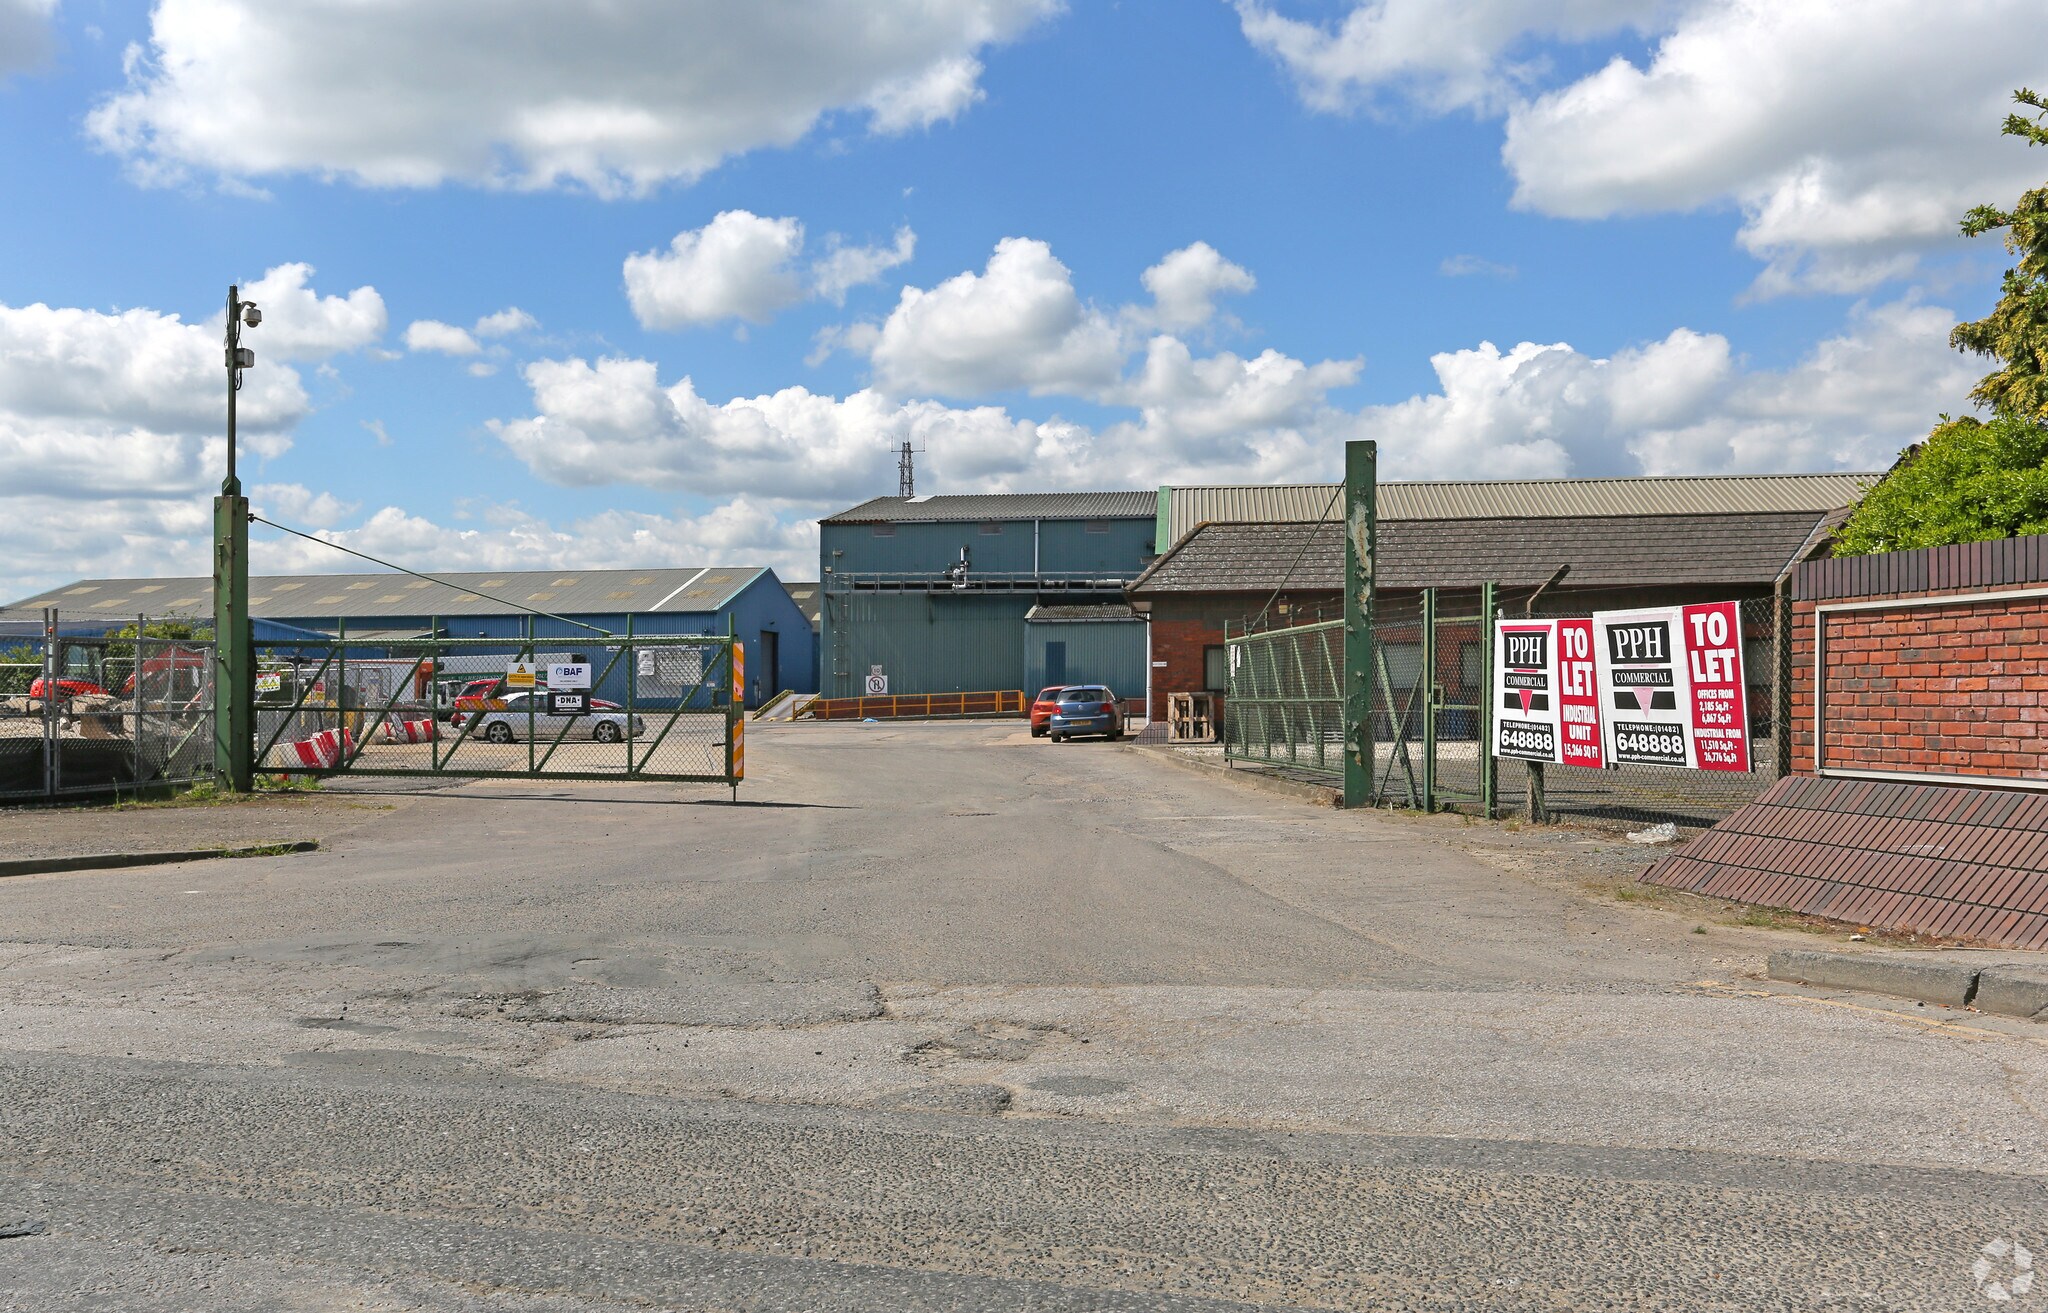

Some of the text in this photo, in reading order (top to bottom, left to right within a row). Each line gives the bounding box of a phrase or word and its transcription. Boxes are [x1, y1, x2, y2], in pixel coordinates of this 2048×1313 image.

[1690, 611, 1728, 646] TO
[1562, 627, 1588, 659] TO
[1613, 626, 1663, 659] PPH
[1508, 636, 1542, 665] PPH
[563, 667, 583, 676] BAF
[1690, 648, 1735, 683] LET
[1506, 675, 1546, 687] COMMERCIAL
[1561, 661, 1593, 697] LET
[1614, 672, 1670, 684] COMMERCIAL
[1697, 689, 1734, 699] OFFICES FROM
[1715, 701, 1729, 713] Sq.Ft
[1562, 704, 1596, 724] INDUSTRIAL
[1717, 713, 1732, 725] Sq.Ft
[1503, 721, 1550, 733] TELEPHONE:(01482)
[1617, 723, 1679, 734] TELEPHONE:(01482)
[1569, 726, 1591, 741] UNIT
[1694, 728, 1742, 739] INDUSTRIAL FROM
[1500, 729, 1553, 751] 648888
[1616, 732, 1684, 755] 648888
[1719, 740, 1734, 752] Sq.Ft
[1500, 748, 1554, 759] www.pph-commercial.co.uk
[1583, 745, 1591, 759] SQ
[1591, 745, 1598, 759] FT
[1618, 753, 1685, 763] www.pph-commercial.co.uk
[1723, 752, 1737, 764] Sq.Ft
